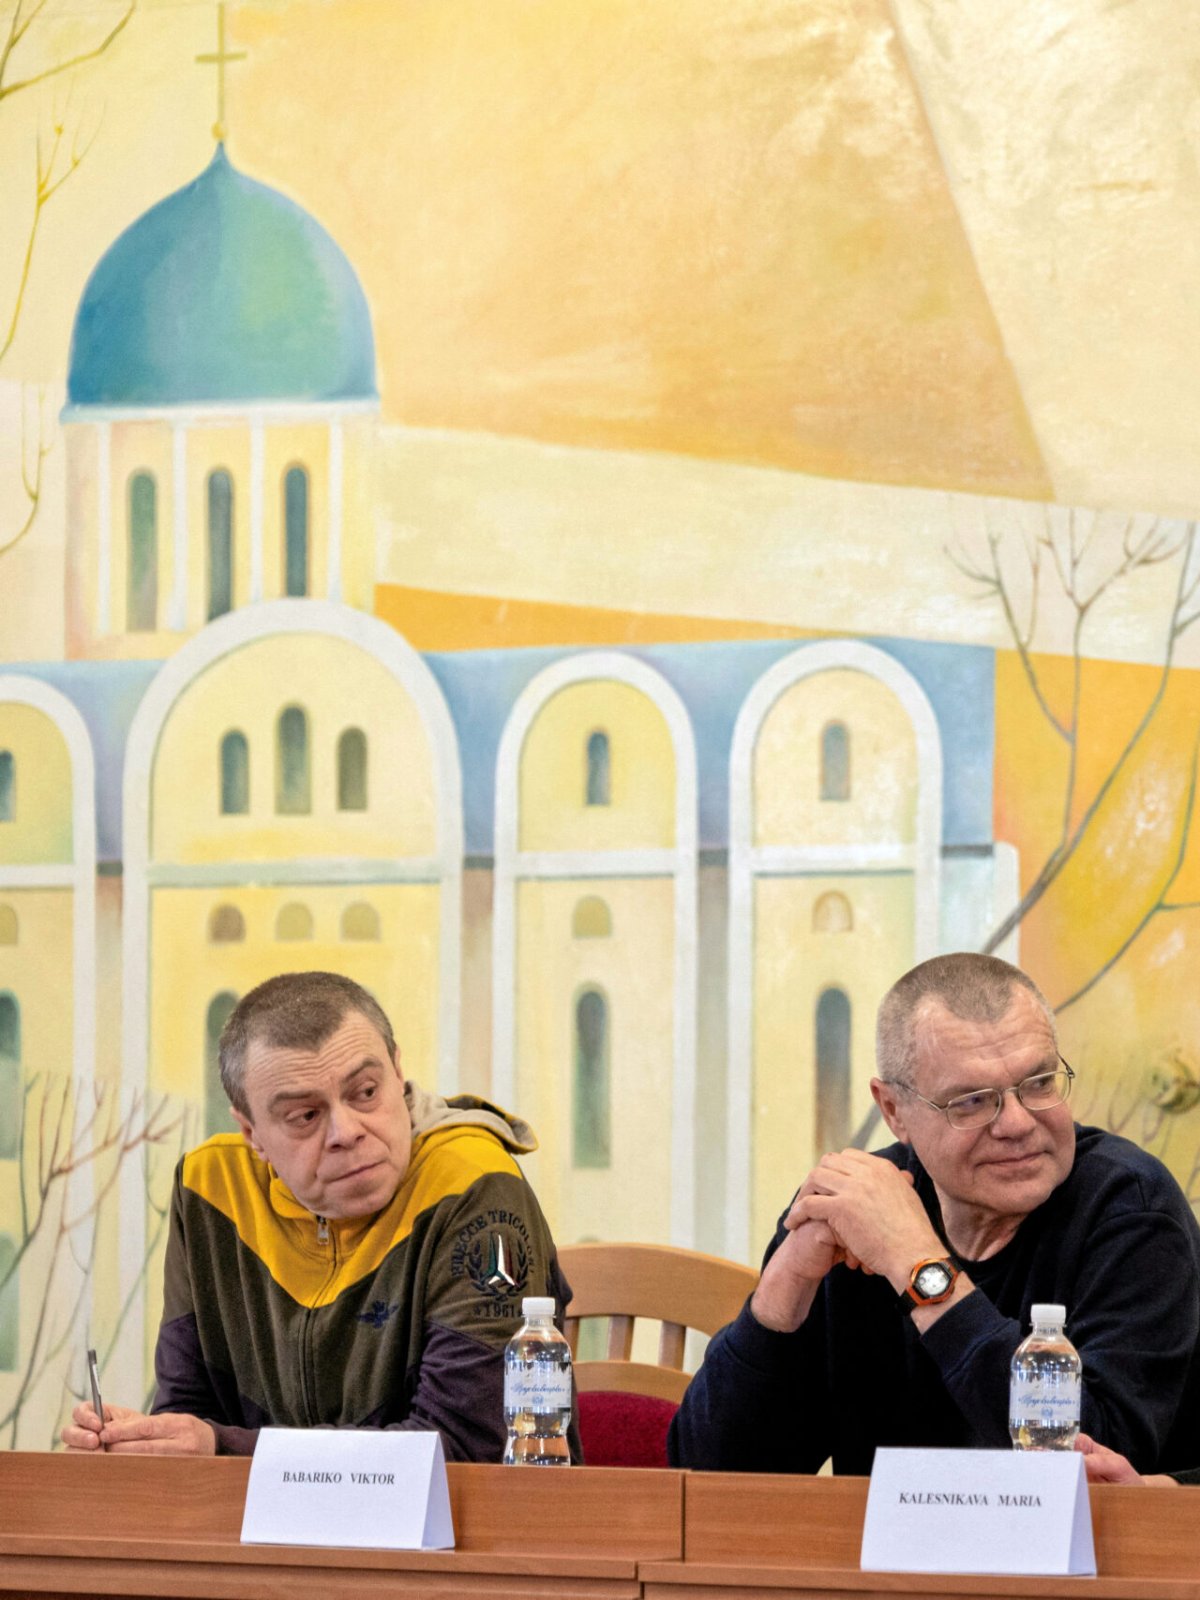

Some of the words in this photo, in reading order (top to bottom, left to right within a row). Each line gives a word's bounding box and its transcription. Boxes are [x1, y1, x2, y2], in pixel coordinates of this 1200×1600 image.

[482, 1303, 515, 1318] 1961
[282, 1471, 342, 1484] BABARIKO
[350, 1472, 395, 1485] VIKTOR
[899, 1492, 989, 1506] KALESNIKAVA
[997, 1494, 1042, 1508] MARIA
